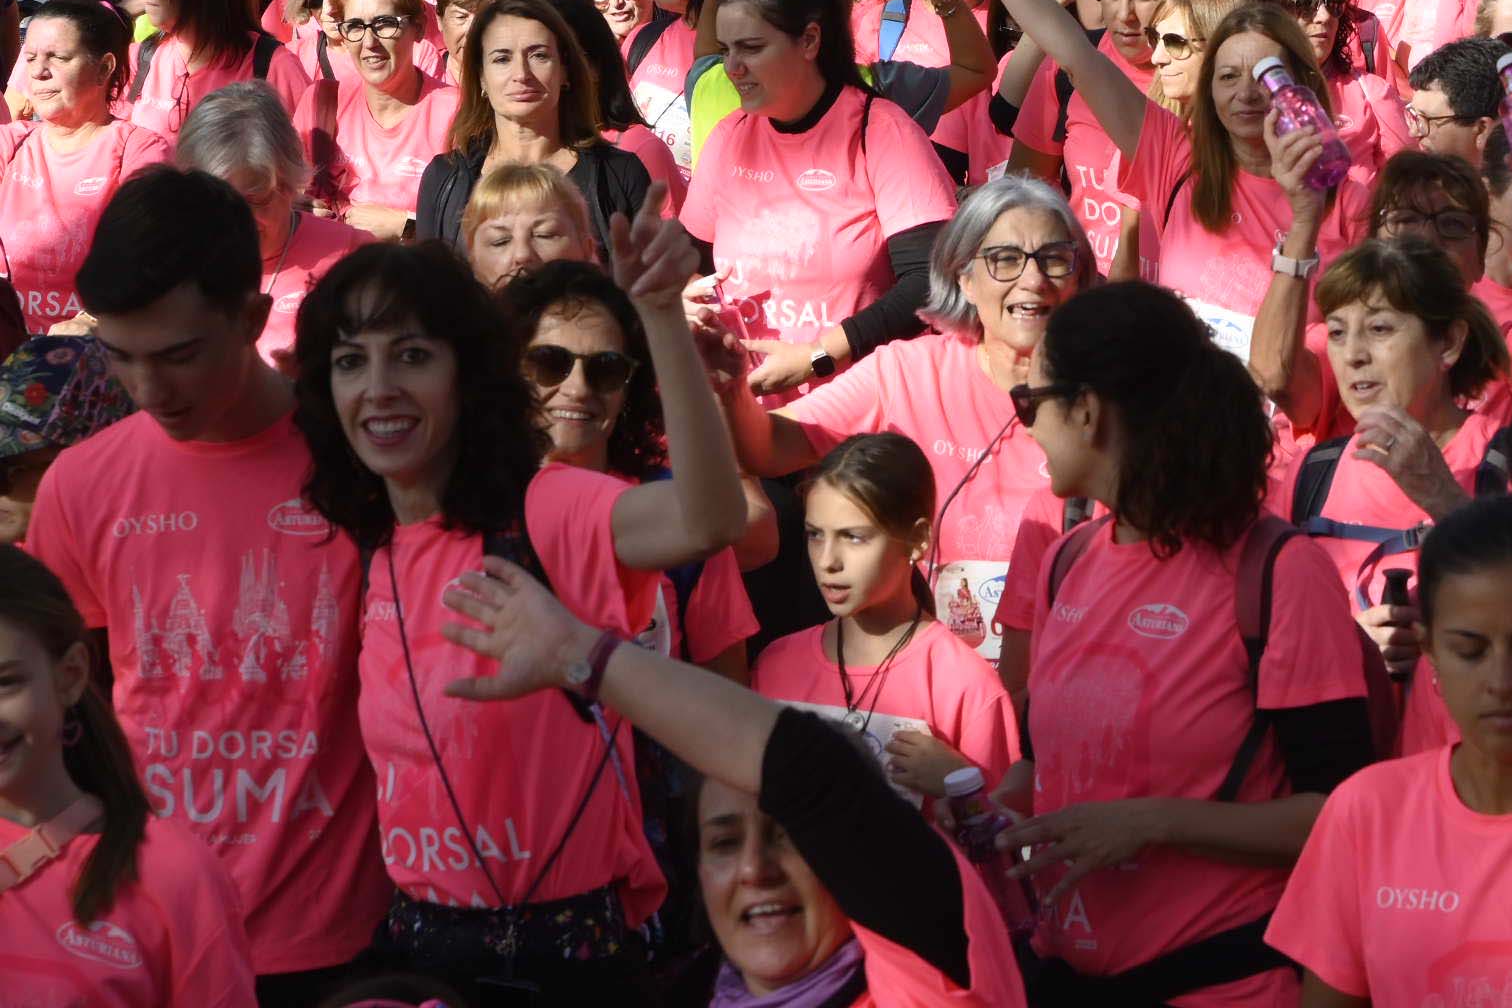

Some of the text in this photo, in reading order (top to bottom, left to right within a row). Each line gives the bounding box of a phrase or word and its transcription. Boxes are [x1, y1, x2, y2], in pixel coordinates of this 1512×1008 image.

[113, 510, 198, 540] OYSHO
[145, 726, 179, 757] TU
[144, 762, 336, 824] SUMA
[1376, 885, 1460, 913] OYSHO
